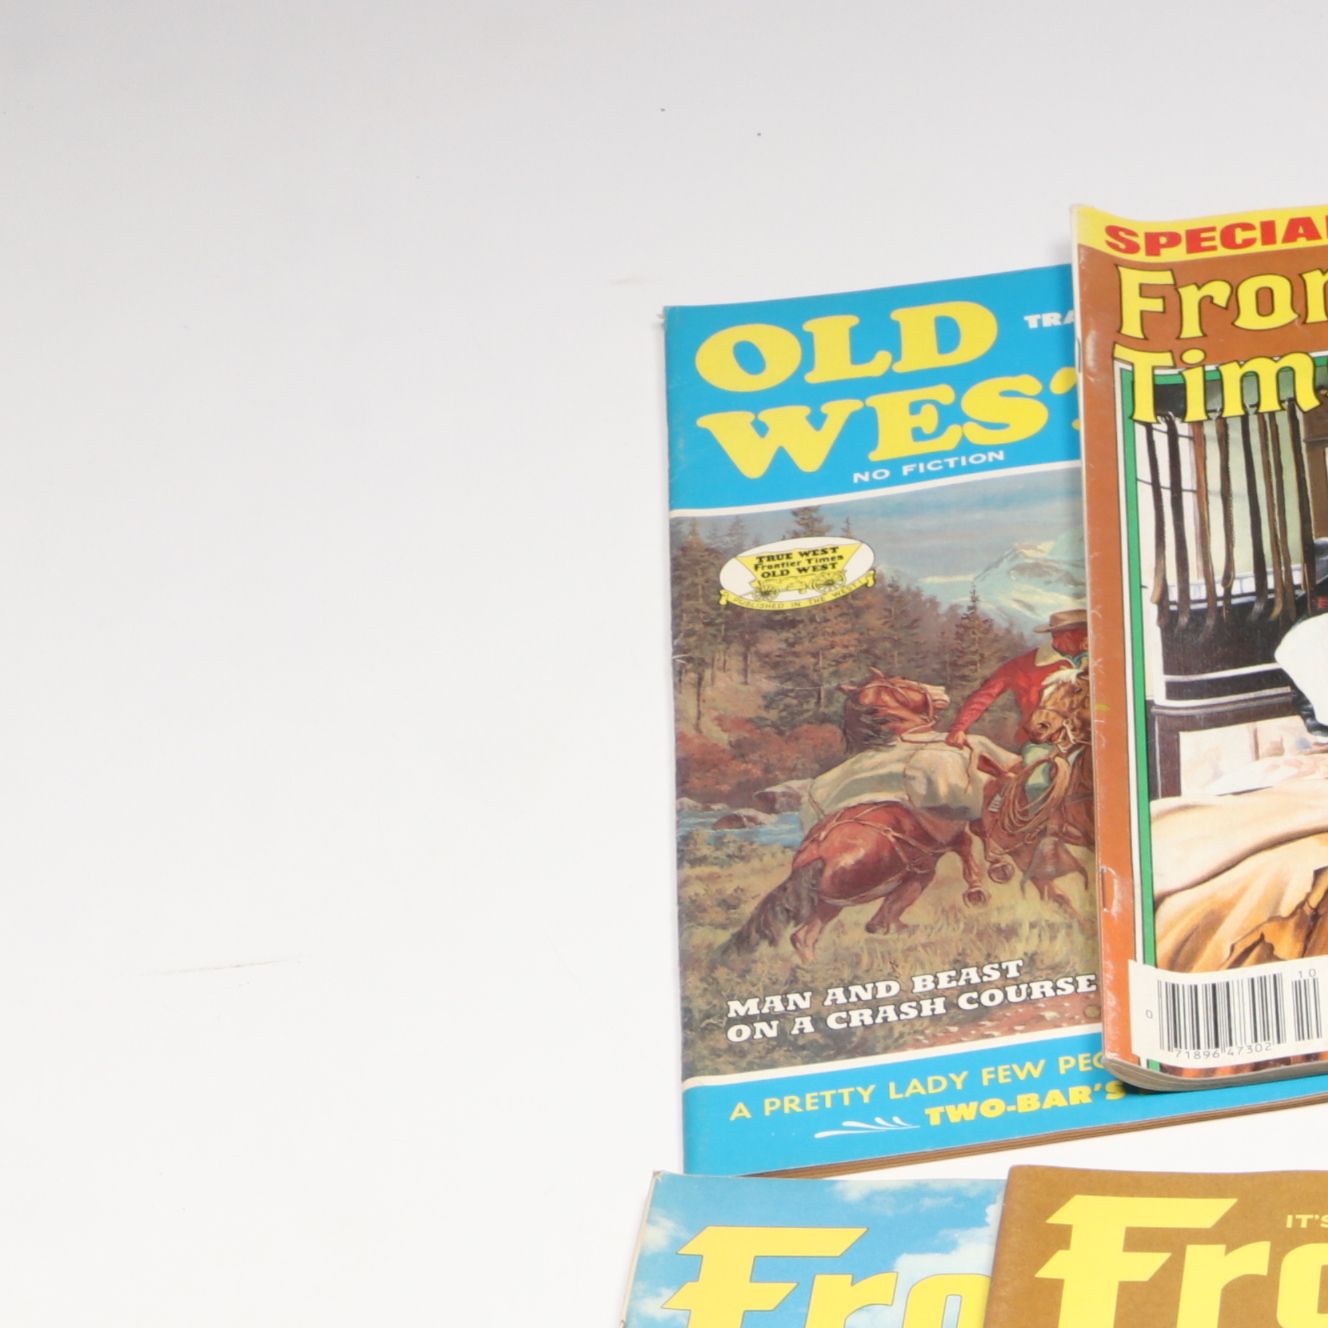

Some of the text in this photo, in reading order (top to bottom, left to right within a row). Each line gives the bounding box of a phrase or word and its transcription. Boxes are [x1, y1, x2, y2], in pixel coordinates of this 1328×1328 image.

[695, 301, 998, 392] OLD
[852, 451, 1004, 484] NO FICTION
[727, 975, 1096, 1043] ON A CRASH COURSE
[728, 961, 1024, 1018] MAN AND BEAST
[731, 1061, 1046, 1121] A PRETTY LADY FEW
